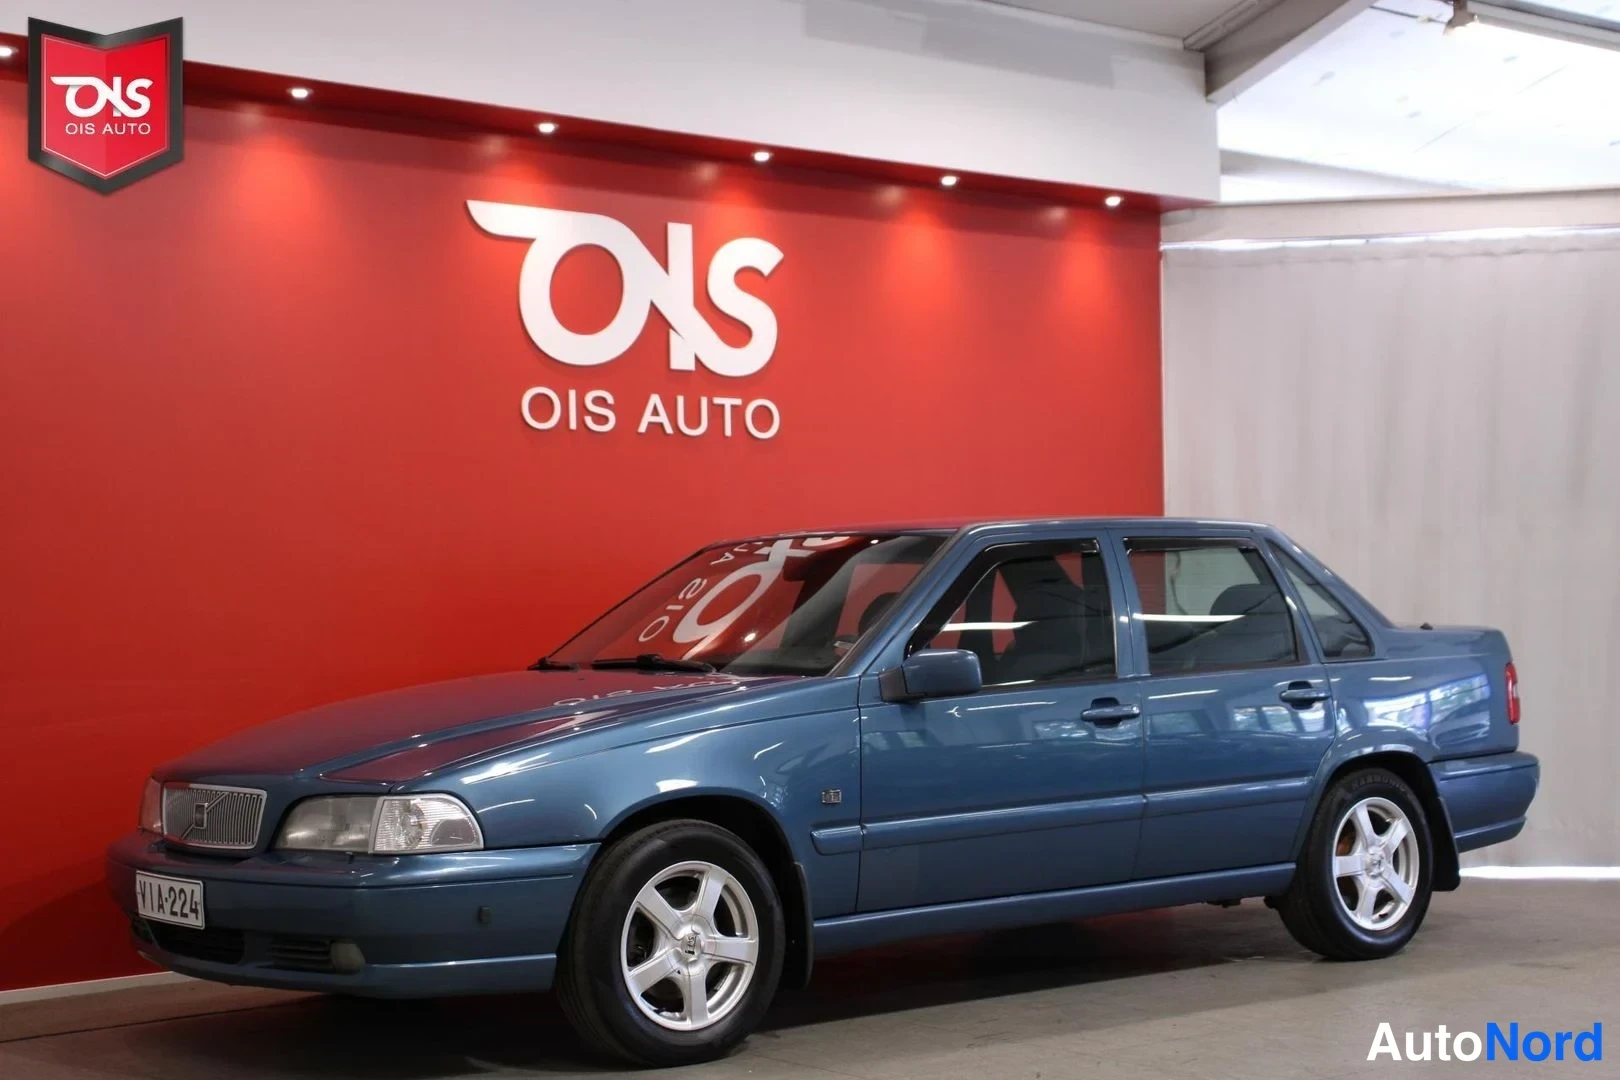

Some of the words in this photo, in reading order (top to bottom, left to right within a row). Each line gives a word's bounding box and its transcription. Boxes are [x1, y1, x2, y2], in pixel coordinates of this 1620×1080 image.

[520, 386, 617, 433] OIS
[637, 393, 781, 440] AUTO
[138, 879, 201, 920] VIA-224
